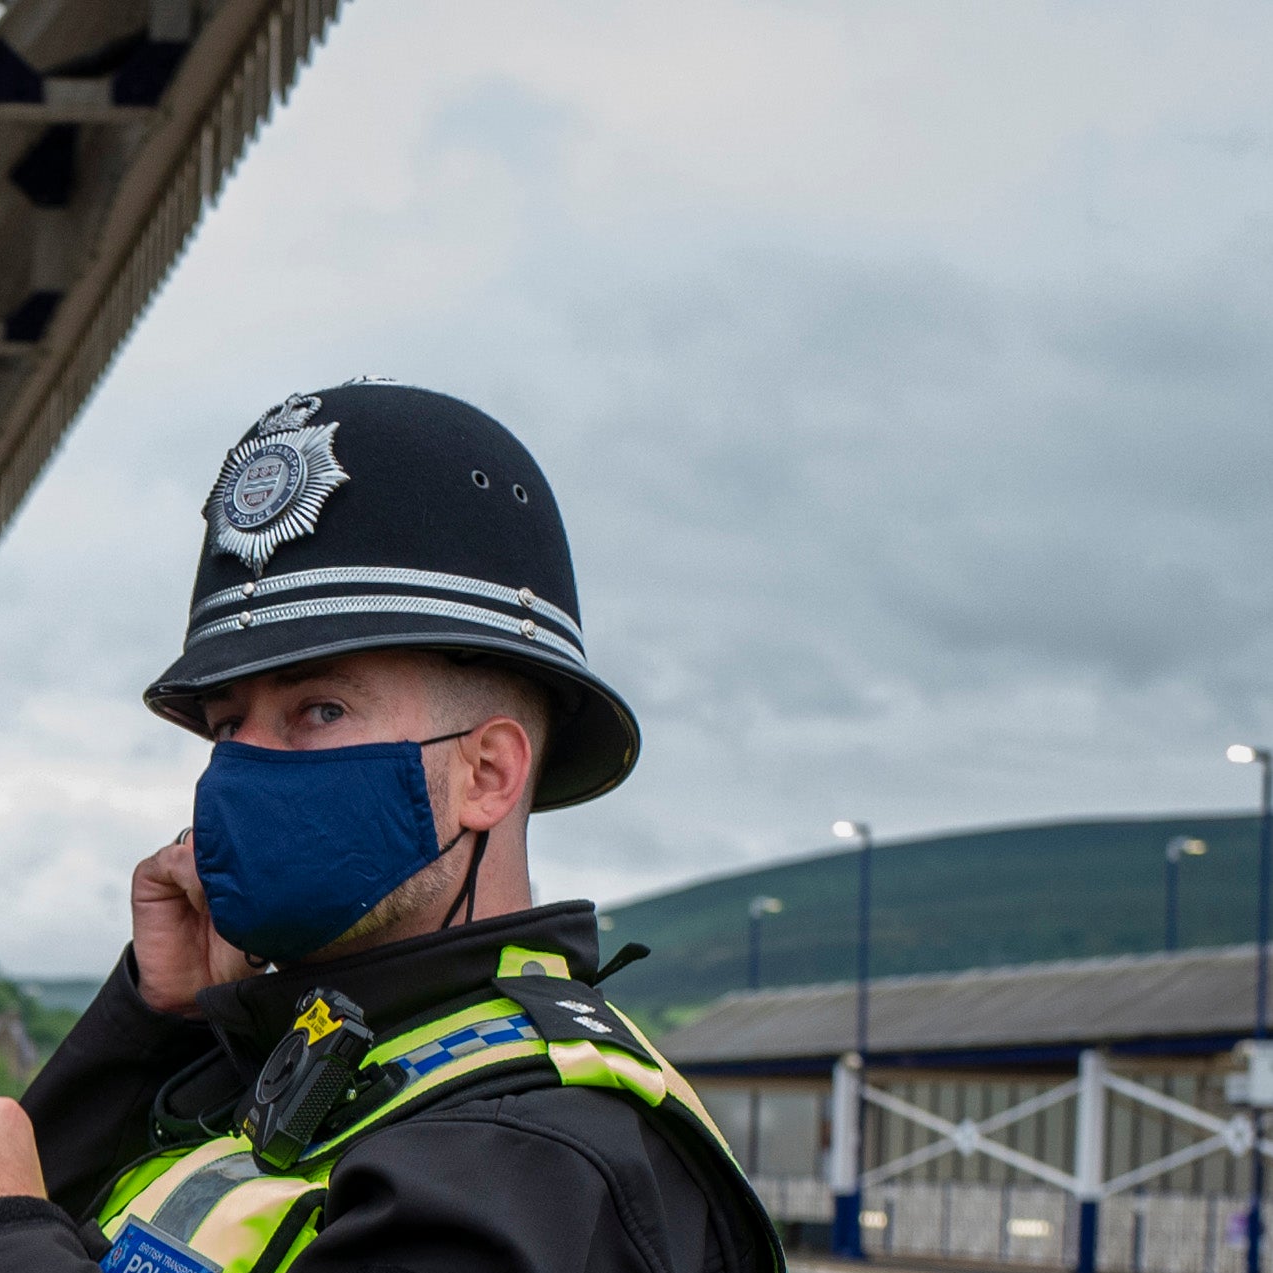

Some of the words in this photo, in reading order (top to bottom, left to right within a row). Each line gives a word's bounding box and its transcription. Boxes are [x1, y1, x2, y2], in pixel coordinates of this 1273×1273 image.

[223, 455, 257, 505] BRITISH
[262, 445, 300, 491] TRANSPORT
[231, 506, 274, 525] POLICE
[138, 1242, 164, 1262] BRITISH
